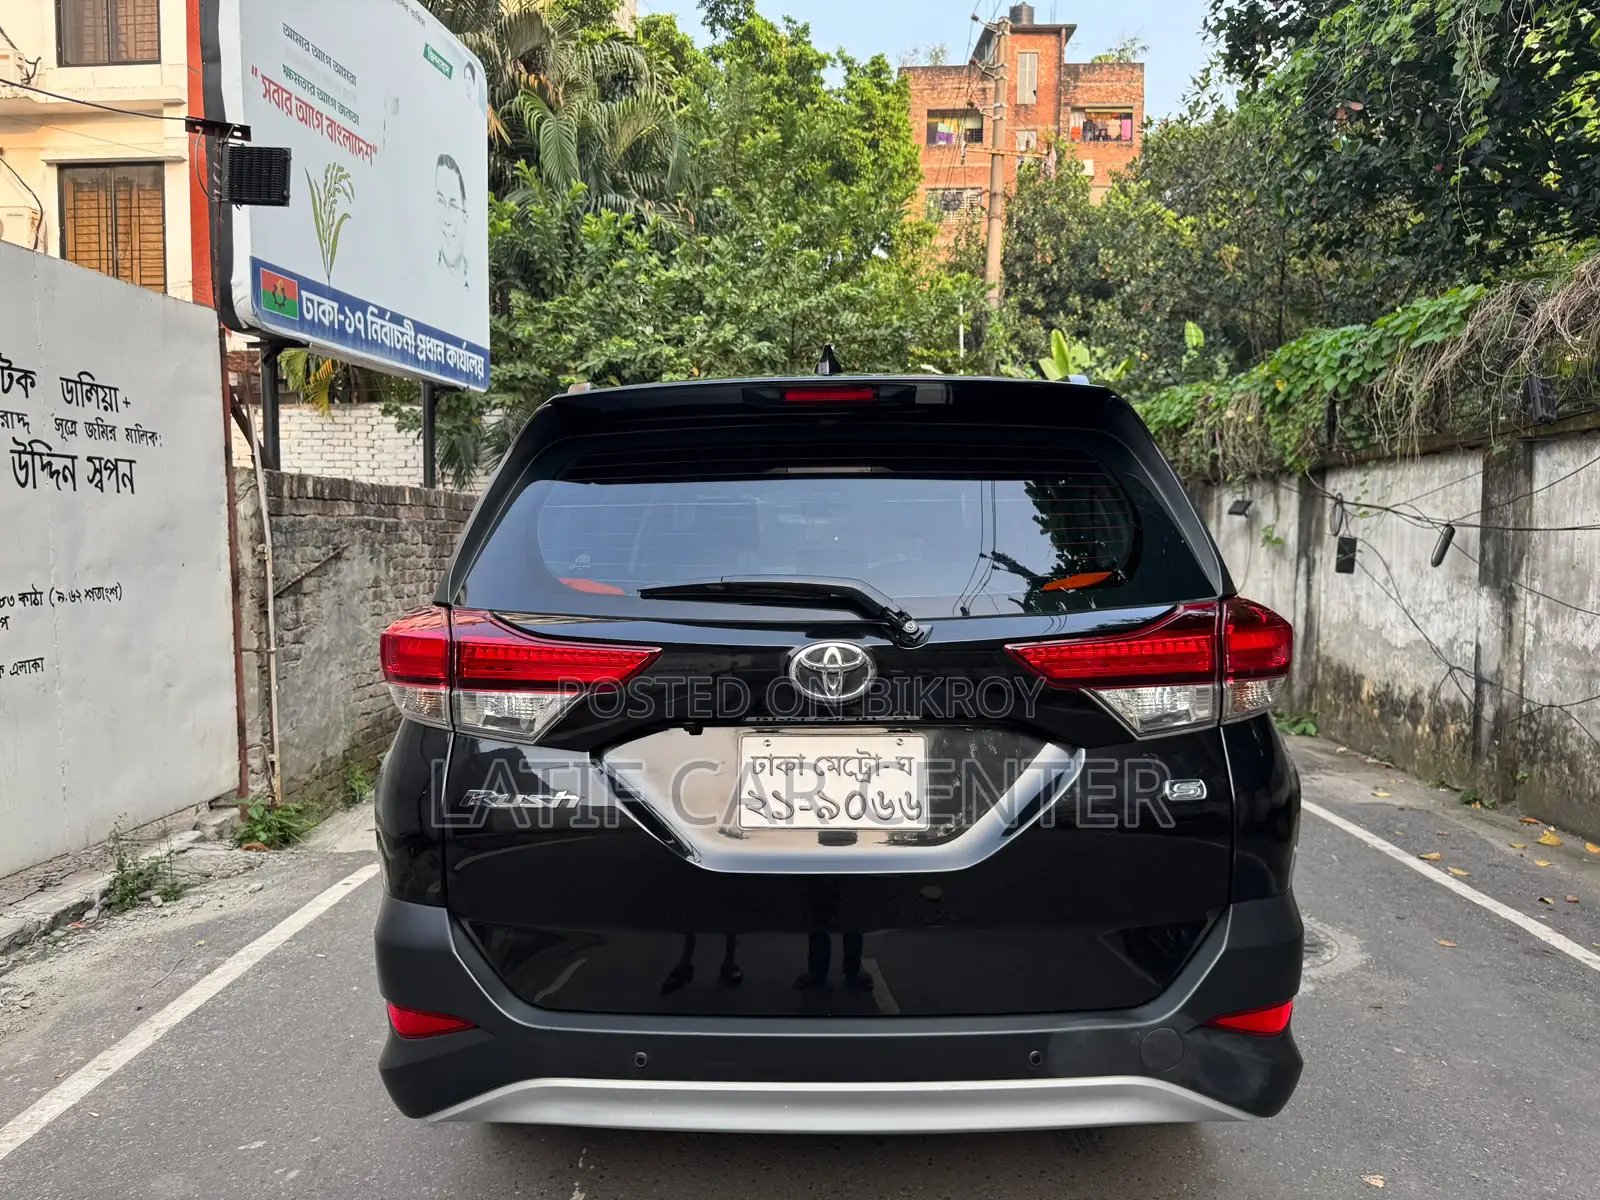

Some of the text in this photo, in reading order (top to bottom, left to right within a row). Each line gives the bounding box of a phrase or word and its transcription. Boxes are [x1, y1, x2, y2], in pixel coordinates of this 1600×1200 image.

[282, 23, 357, 87] আমার আগে আমরা
[282, 64, 315, 96] ক্ষমতার
[317, 87, 337, 111] আগে
[294, 95, 324, 137] আগে
[301, 289, 485, 380] ঢাকা-১৭ নির্বাচনী প্রধান কার্যালয়
[54, 416, 78, 442] সূত্রে
[84, 417, 117, 442] জমির
[9, 436, 136, 494] উদ্দিন স্বপন
[18, 584, 44, 608] কাঠা
[9, 657, 45, 676] এলাকা
[750, 753, 807, 777] ঢাকা
[459, 789, 581, 808] Rush
[745, 790, 922, 820] ২১-৯০৬৬
